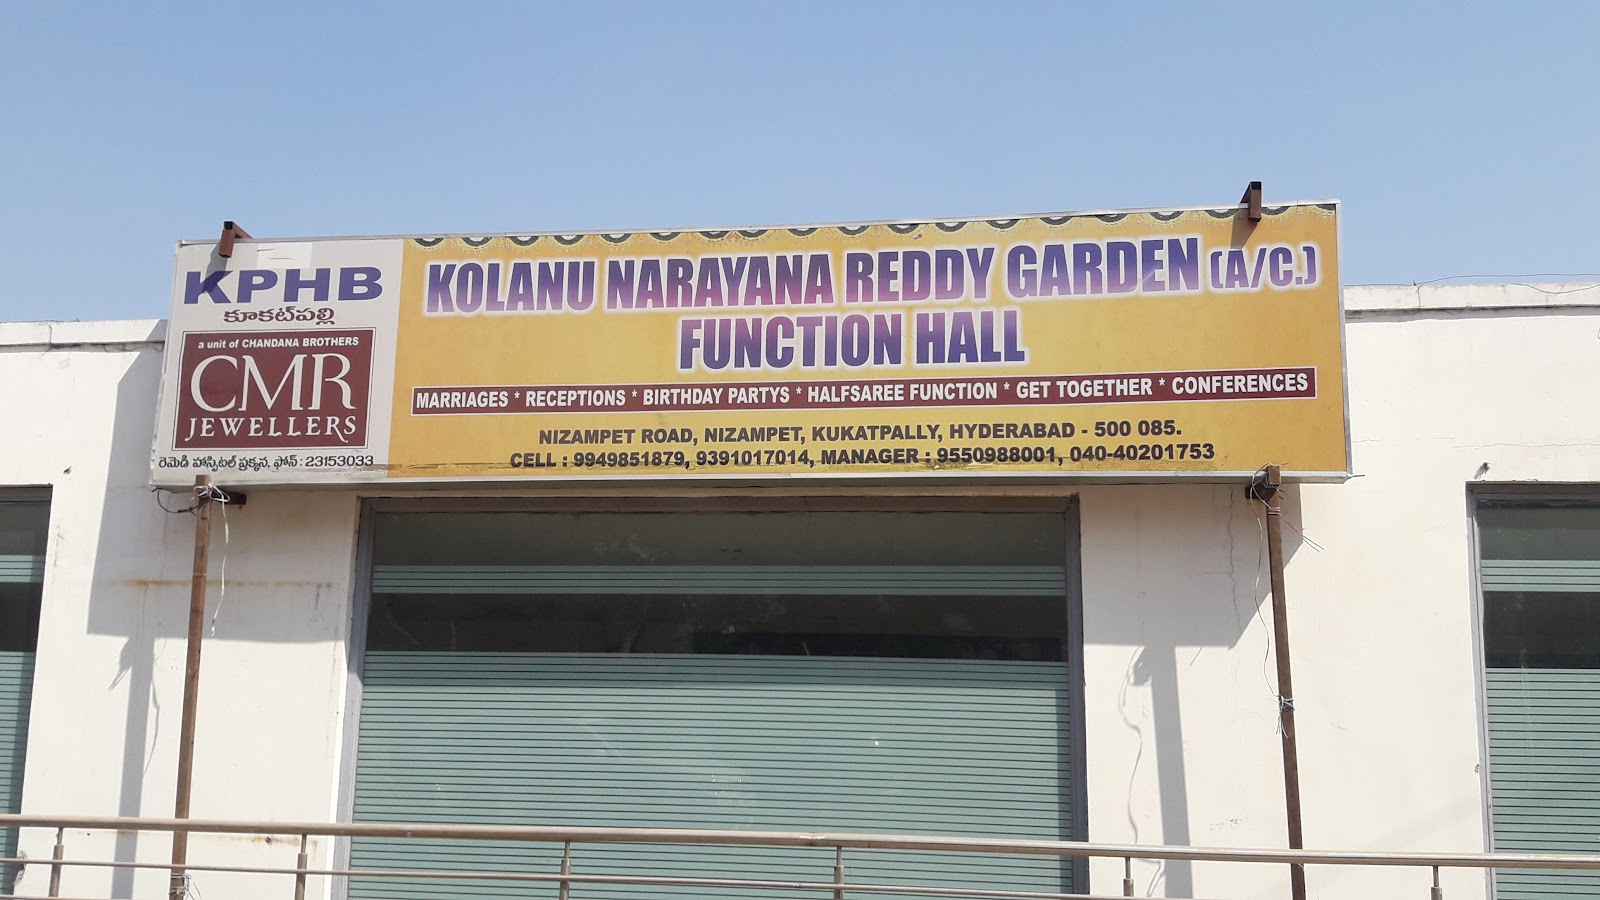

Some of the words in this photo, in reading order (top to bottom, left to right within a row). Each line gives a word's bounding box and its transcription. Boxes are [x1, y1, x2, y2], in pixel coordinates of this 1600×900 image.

[184, 266, 383, 304] KPHB
[427, 260, 595, 314] KOLANU
[606, 253, 834, 310] NARAYANA
[845, 247, 995, 303] REDDY
[1007, 237, 1199, 299] GARDEN
[1210, 245, 1317, 289] (A/C.)
[198, 341, 205, 349] a
[207, 340, 227, 349] unit
[229, 339, 239, 349] of
[242, 338, 299, 348] CHANDANA
[302, 336, 359, 347] BROTHERS
[680, 312, 902, 370] FUNCTION
[915, 310, 1025, 364] HALL
[190, 353, 357, 412] CMR
[416, 391, 509, 409] MARRIAGES
[525, 389, 626, 407] RECEPTIONS
[643, 387, 723, 405] BIRTHDAY
[728, 386, 790, 404] PARTYS
[807, 383, 904, 402] HALFSAREE
[909, 382, 998, 400] FUNCTION
[1016, 380, 1050, 398] GET
[1056, 377, 1153, 397] TOGETHER
[1171, 373, 1309, 395] CONFERENCES
[184, 415, 357, 443] JEWELLERS
[539, 429, 636, 445] NIZAMPET
[641, 428, 698, 446] ROAD,
[704, 426, 806, 445] NIZAMPET,
[812, 424, 943, 443] KUKATPALLY,
[949, 422, 1076, 439] HYDERABAD
[1094, 421, 1132, 437] 500
[1137, 419, 1182, 436] 085.
[305, 455, 374, 467] 23153033
[510, 453, 557, 468] CELL
[573, 450, 690, 469] 9949851879,
[696, 449, 814, 468] 9391017014,
[821, 448, 920, 465] MANAGER
[936, 446, 1063, 465] 9550988001,
[1069, 443, 1215, 462] 040-40201753
